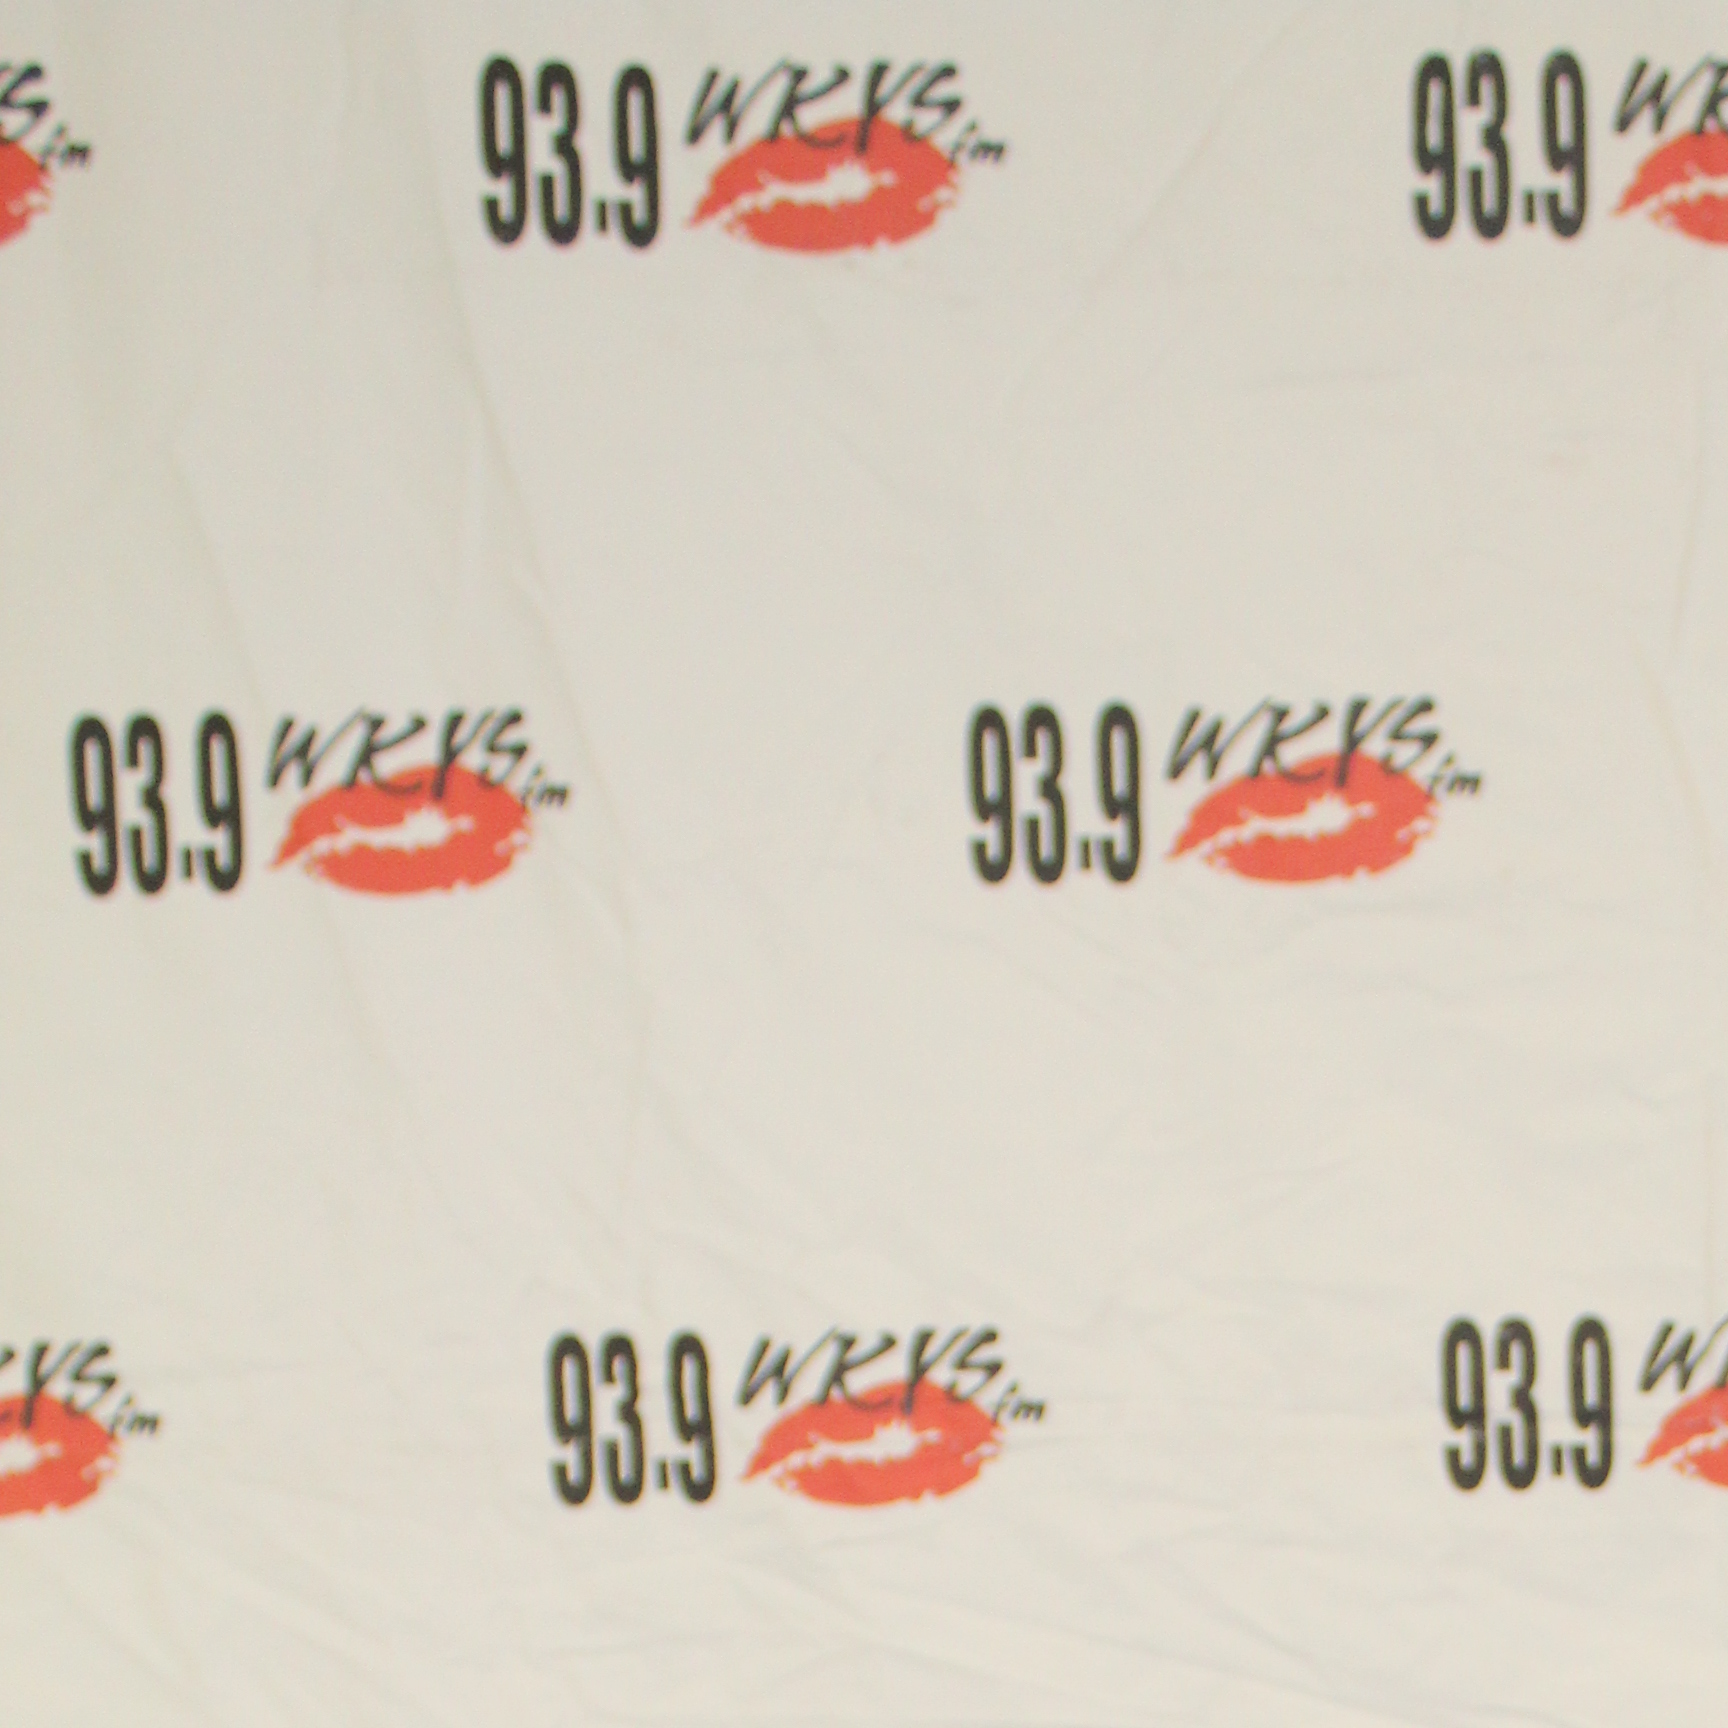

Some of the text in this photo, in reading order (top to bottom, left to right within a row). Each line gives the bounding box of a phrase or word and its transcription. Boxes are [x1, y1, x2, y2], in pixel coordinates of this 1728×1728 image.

[477, 54, 662, 251] 93.9
[684, 60, 965, 158] WKYS
[1410, 48, 1589, 242] 93.9
[68, 710, 245, 898] 93.9
[266, 708, 531, 804] WKYS
[966, 701, 1143, 885] 93.9
[1166, 697, 1440, 788] WKYS
[547, 1331, 717, 1507] 93.9
[738, 1328, 1004, 1414] WKYS
[1441, 1316, 1615, 1492] 93.9
